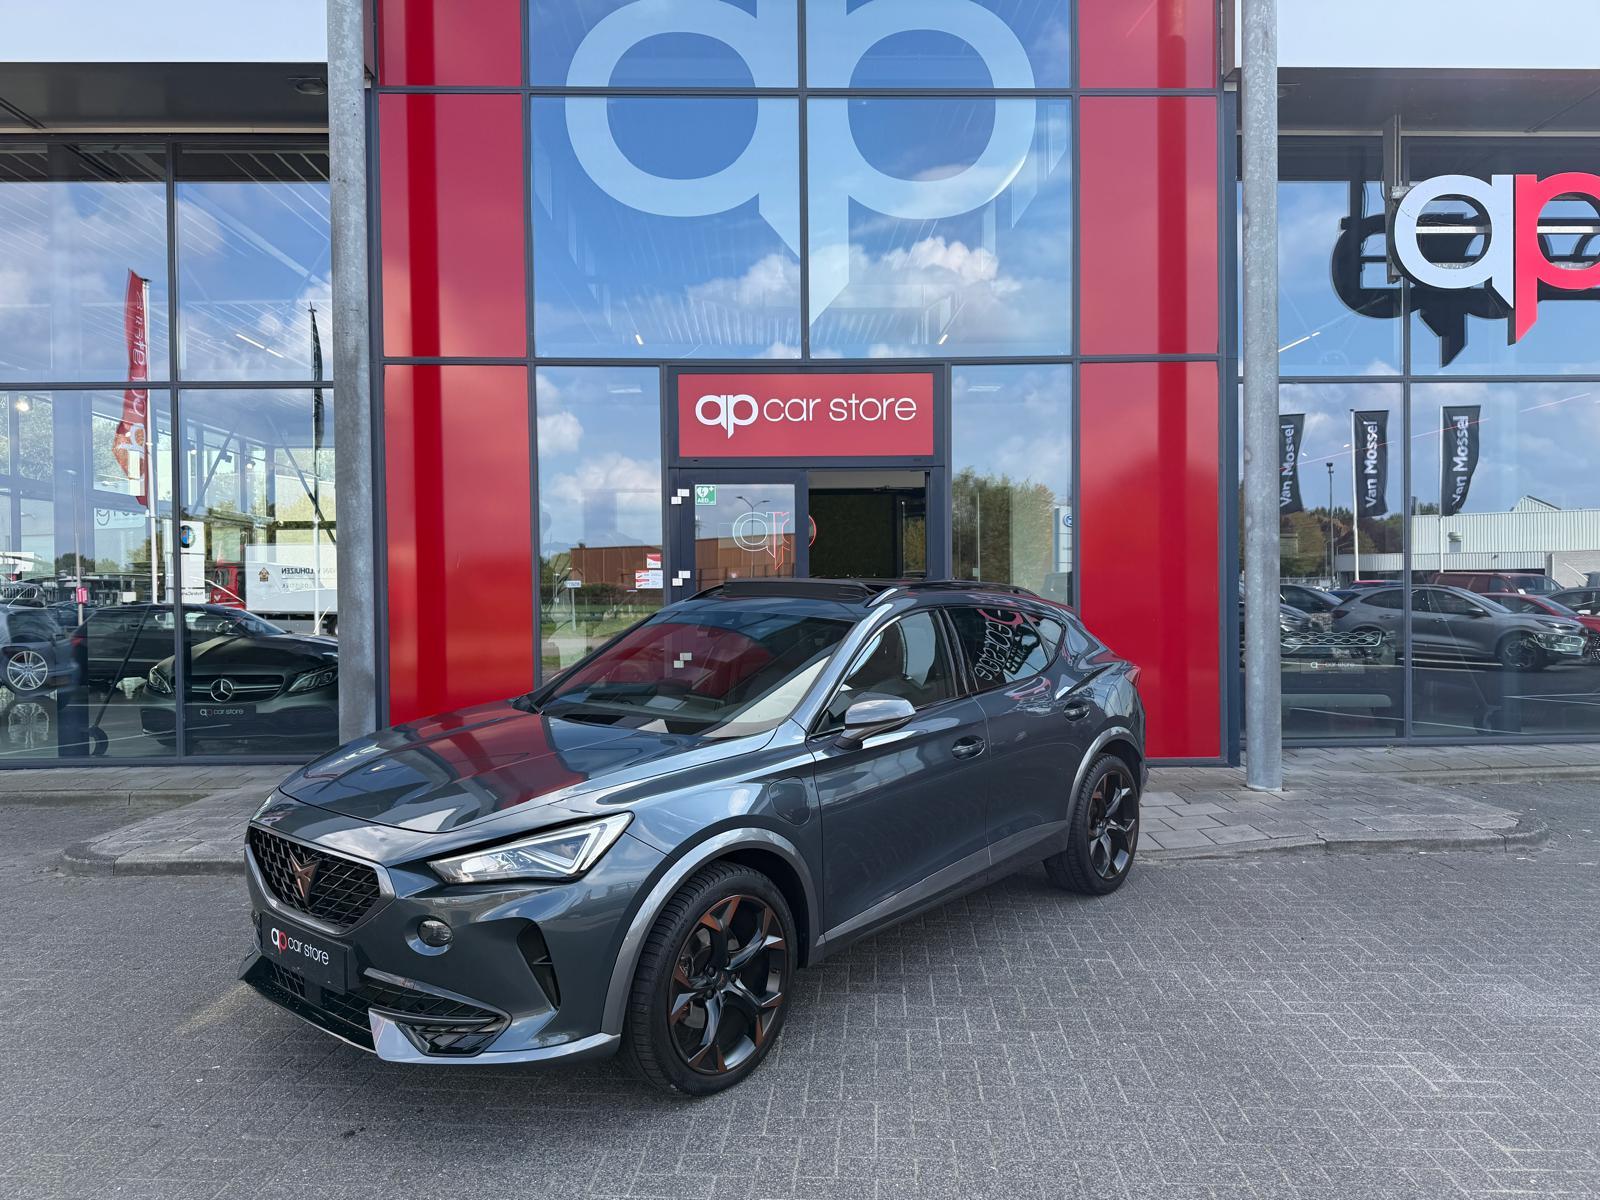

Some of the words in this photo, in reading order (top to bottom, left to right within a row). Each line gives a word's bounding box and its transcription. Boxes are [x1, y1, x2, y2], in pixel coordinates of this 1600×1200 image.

[695, 394, 759, 439] ap
[763, 398, 822, 422] car
[828, 392, 917, 422] store
[1281, 424, 1295, 475] Mossel
[1363, 420, 1378, 474] Mossel
[1452, 415, 1469, 473] Mossel
[1279, 480, 1294, 508] Van
[1364, 477, 1378, 508] Van
[1451, 475, 1468, 505] Van
[287, 937, 302, 952] car
[303, 943, 329, 966] store
